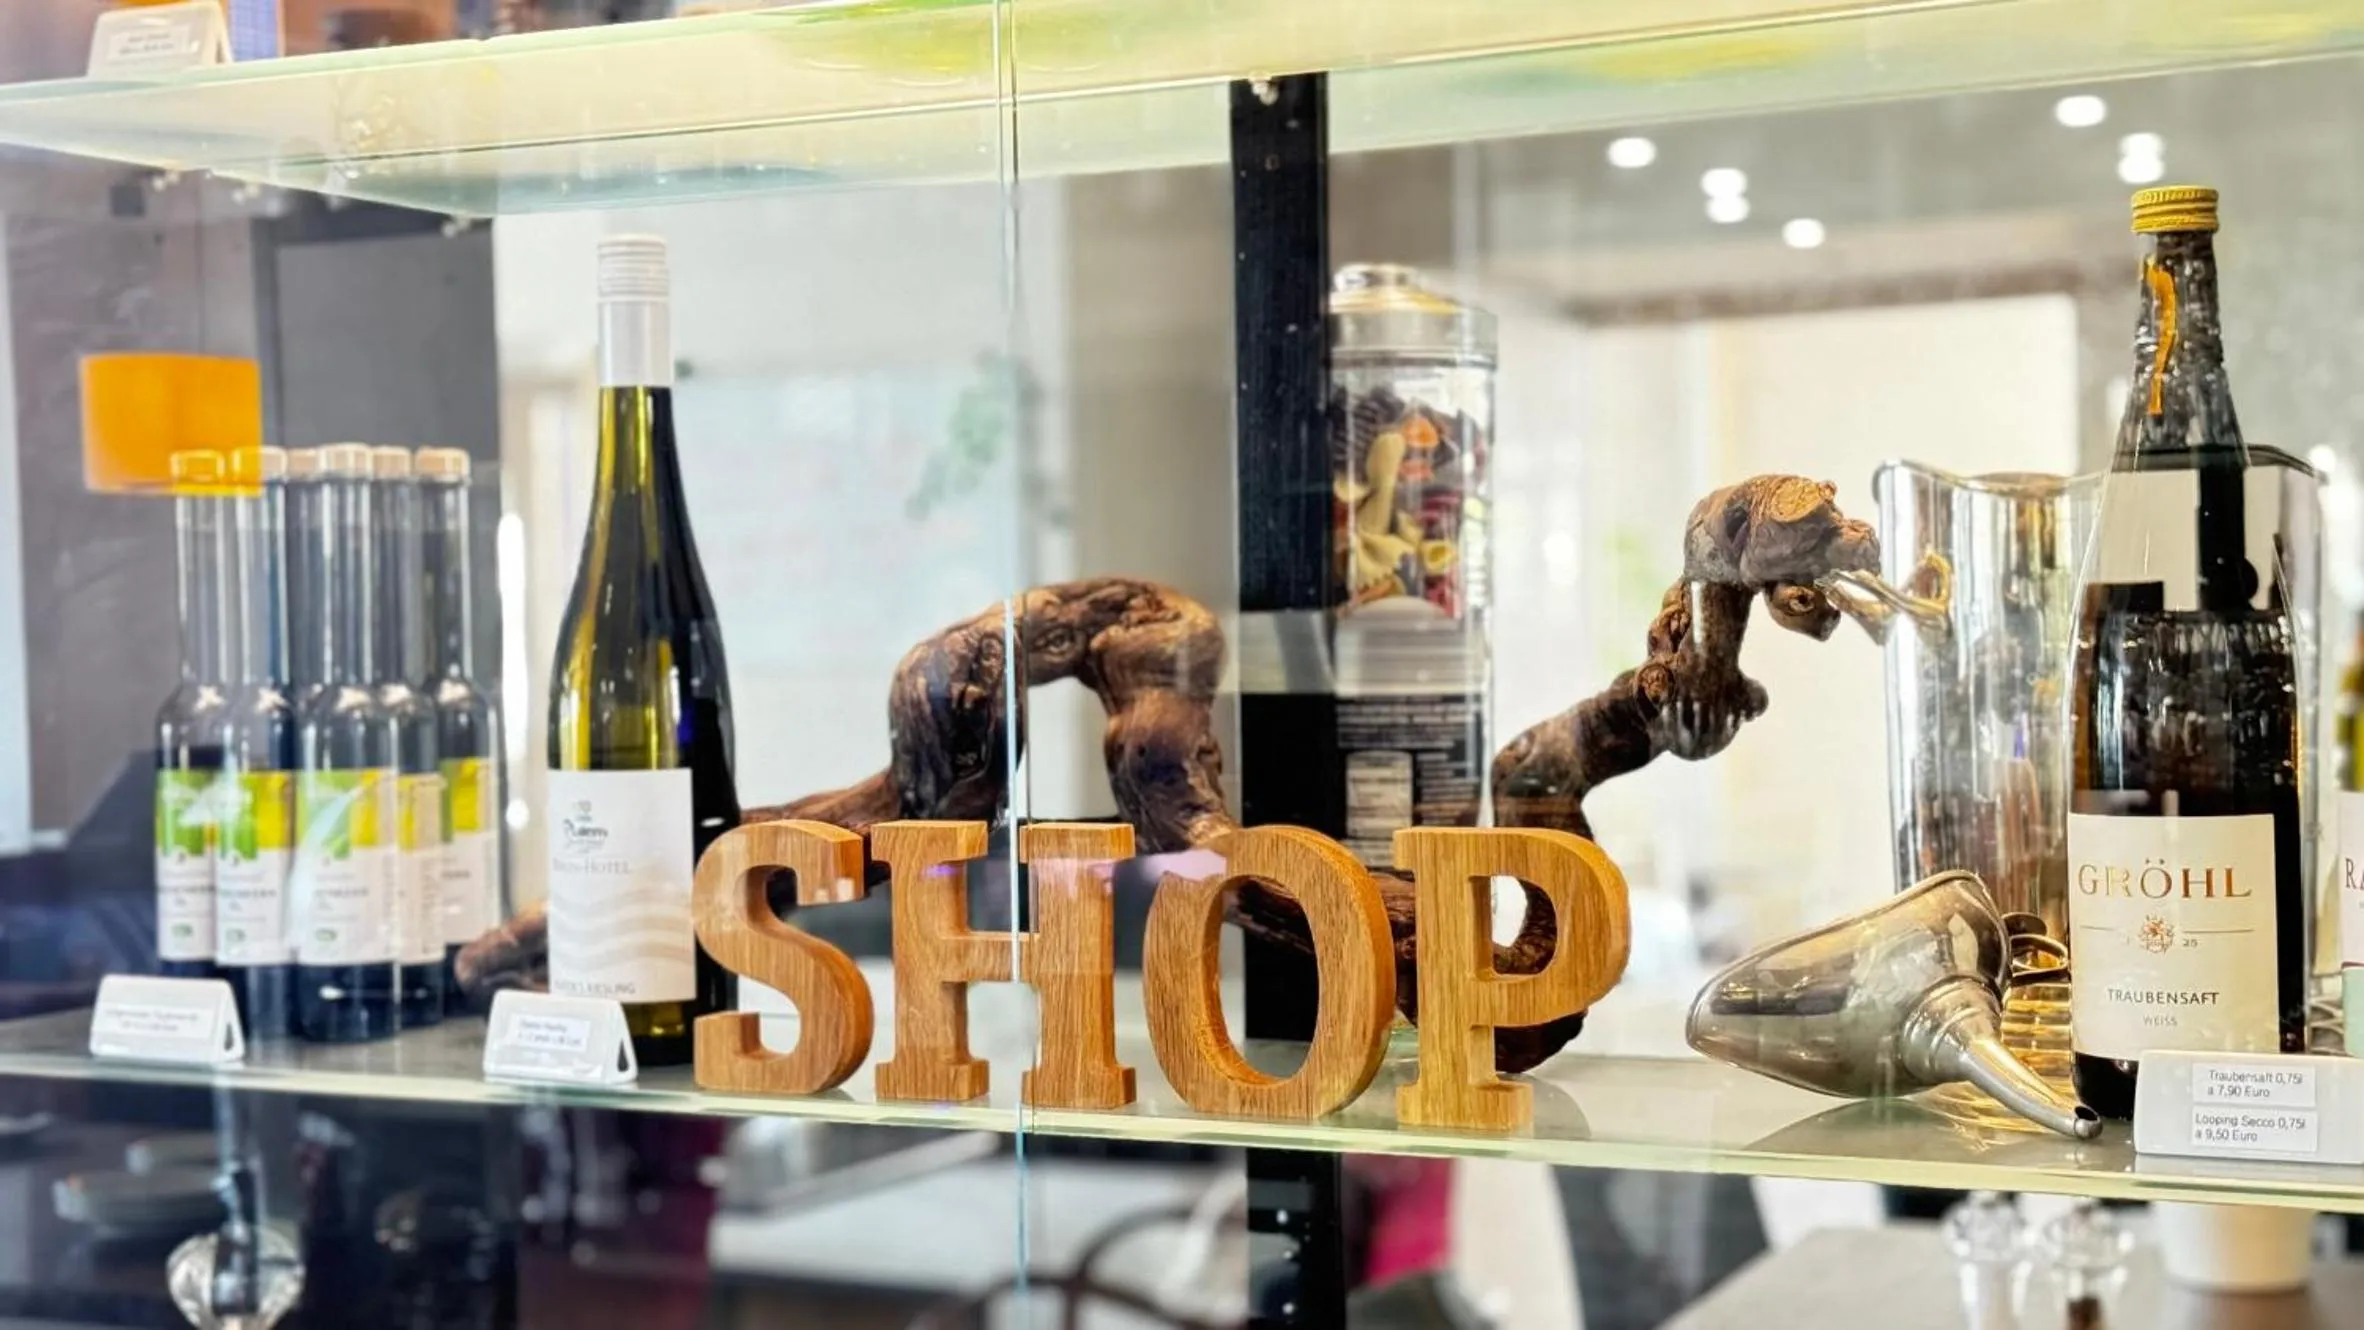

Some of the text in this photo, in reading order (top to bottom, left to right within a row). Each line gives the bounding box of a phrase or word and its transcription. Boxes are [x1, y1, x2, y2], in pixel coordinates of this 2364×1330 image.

[2078, 857, 2253, 899] GRÖHL
[2344, 857, 2364, 891] R
[693, 819, 1631, 1130] SHOP
[2107, 988, 2221, 1006] TRAUBENSAFT
[2142, 1014, 2178, 1027] WEISS
[2208, 1069, 2273, 1084] Traubensaft
[2217, 1084, 2242, 1098] 7,90
[2244, 1086, 2270, 1098] Euro
[2195, 1113, 2239, 1128] Looping
[2241, 1115, 2276, 1128] Secco
[2204, 1128, 2230, 1142] 9,50
[2232, 1129, 2259, 1142] Euro
